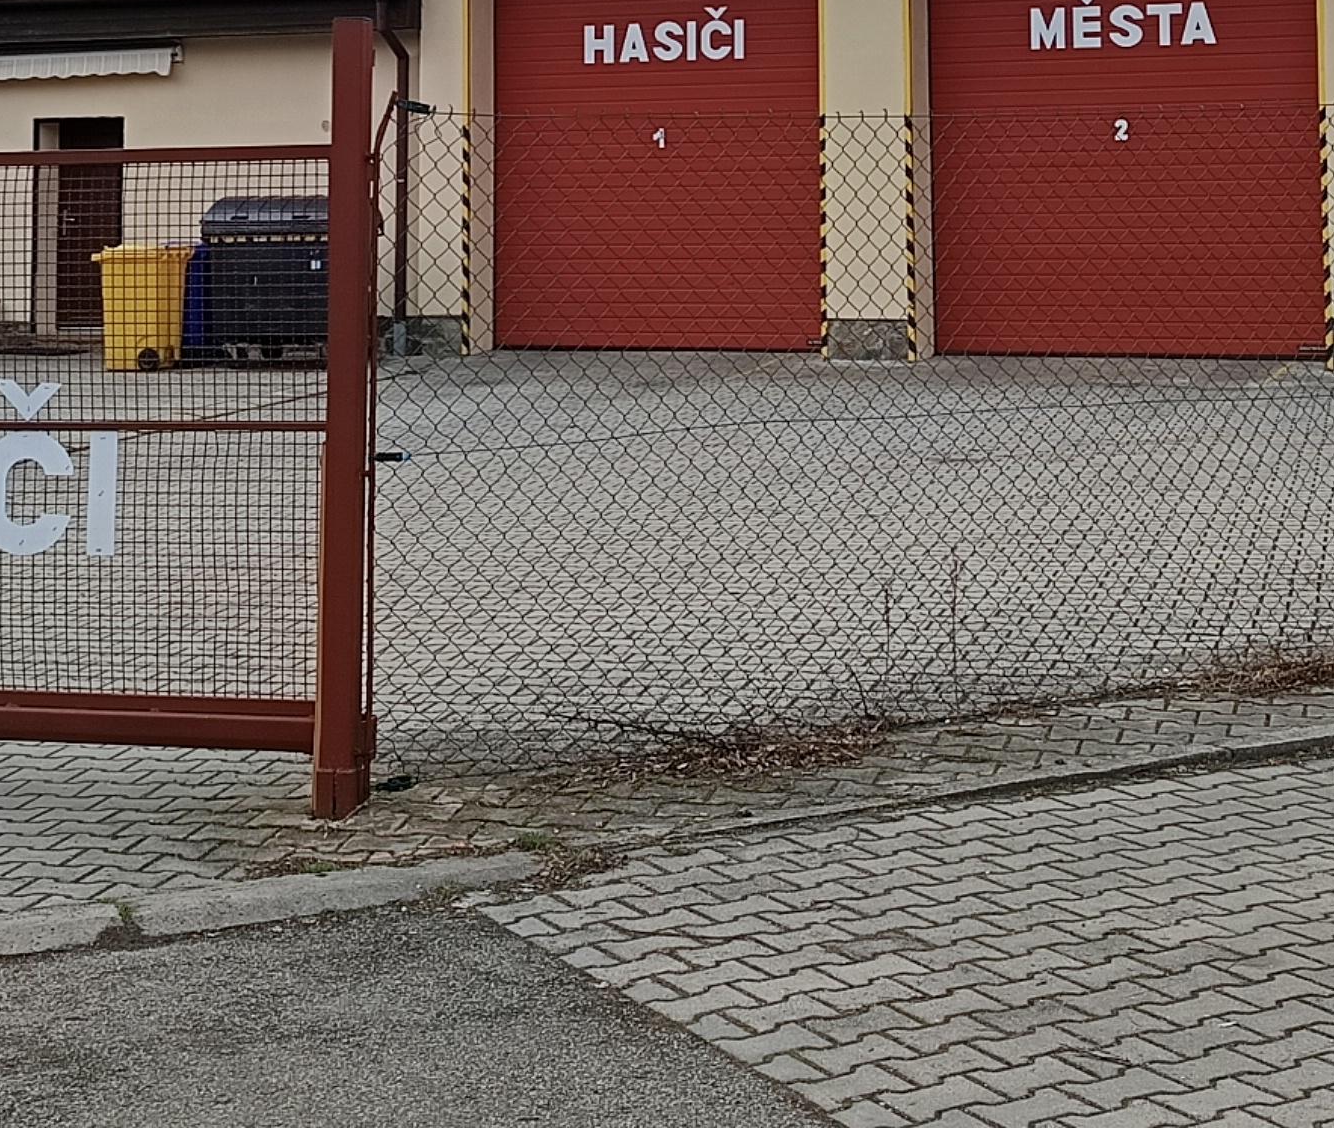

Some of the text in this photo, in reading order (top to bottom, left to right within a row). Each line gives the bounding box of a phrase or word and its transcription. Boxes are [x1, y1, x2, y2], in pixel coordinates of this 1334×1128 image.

[583, 6, 745, 64] HASIČI
[652, 127, 665, 149] 1
[1114, 118, 1129, 141] 2
